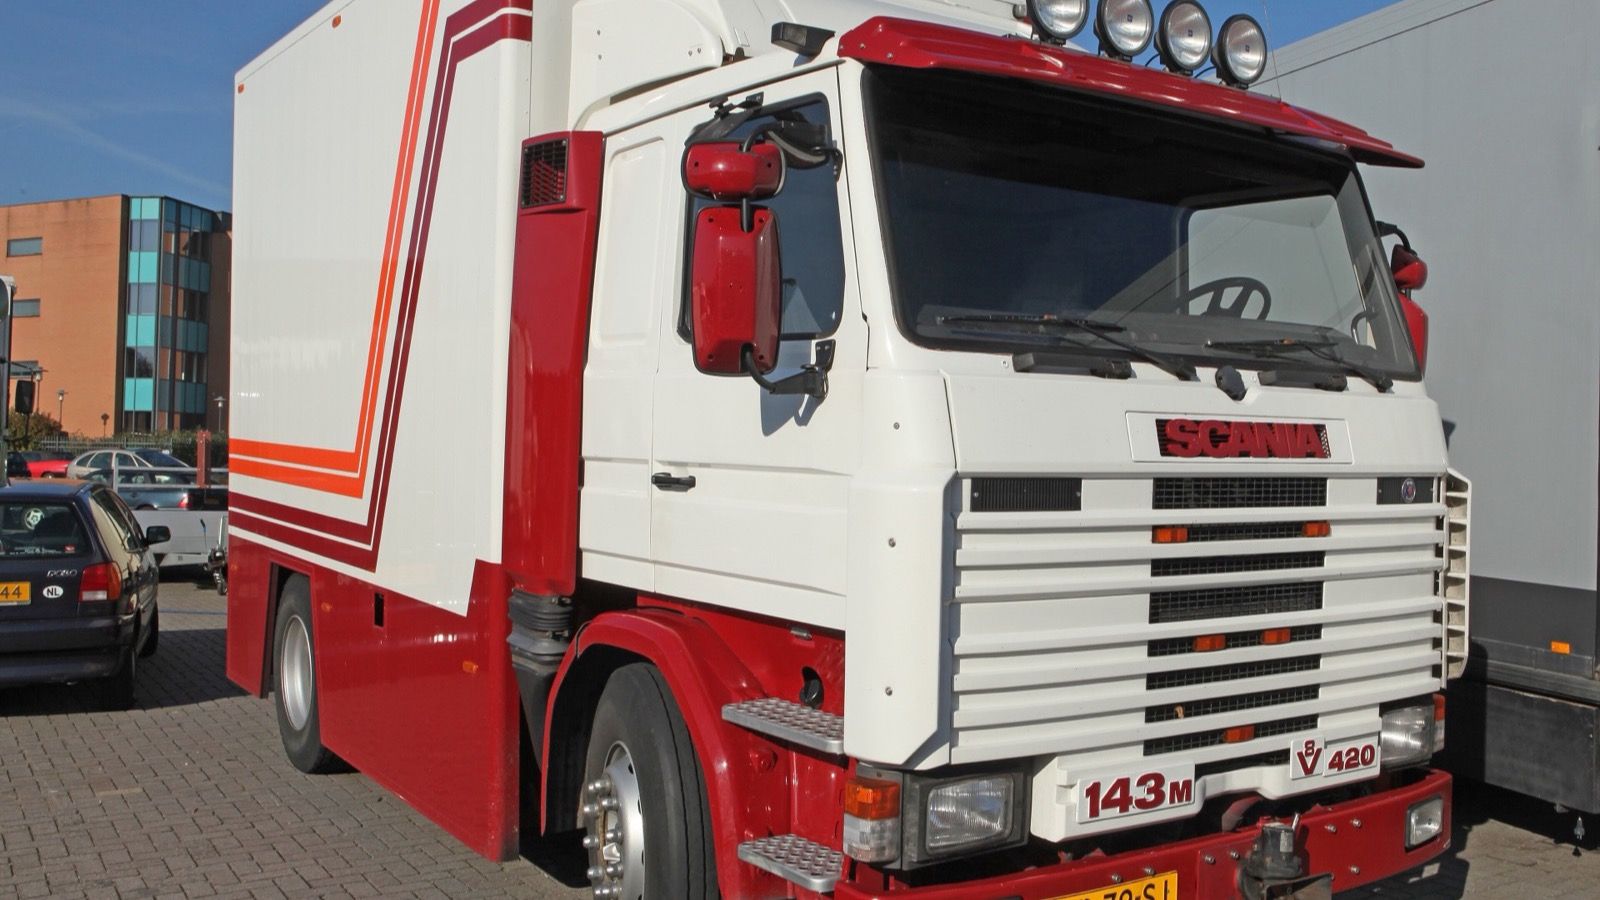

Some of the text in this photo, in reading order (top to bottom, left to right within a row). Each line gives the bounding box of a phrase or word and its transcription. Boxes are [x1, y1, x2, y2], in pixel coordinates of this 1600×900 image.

[1165, 419, 1328, 458] SCANIA
[0, 585, 21, 599] 44
[47, 587, 60, 597] NL
[1328, 744, 1375, 771] 420
